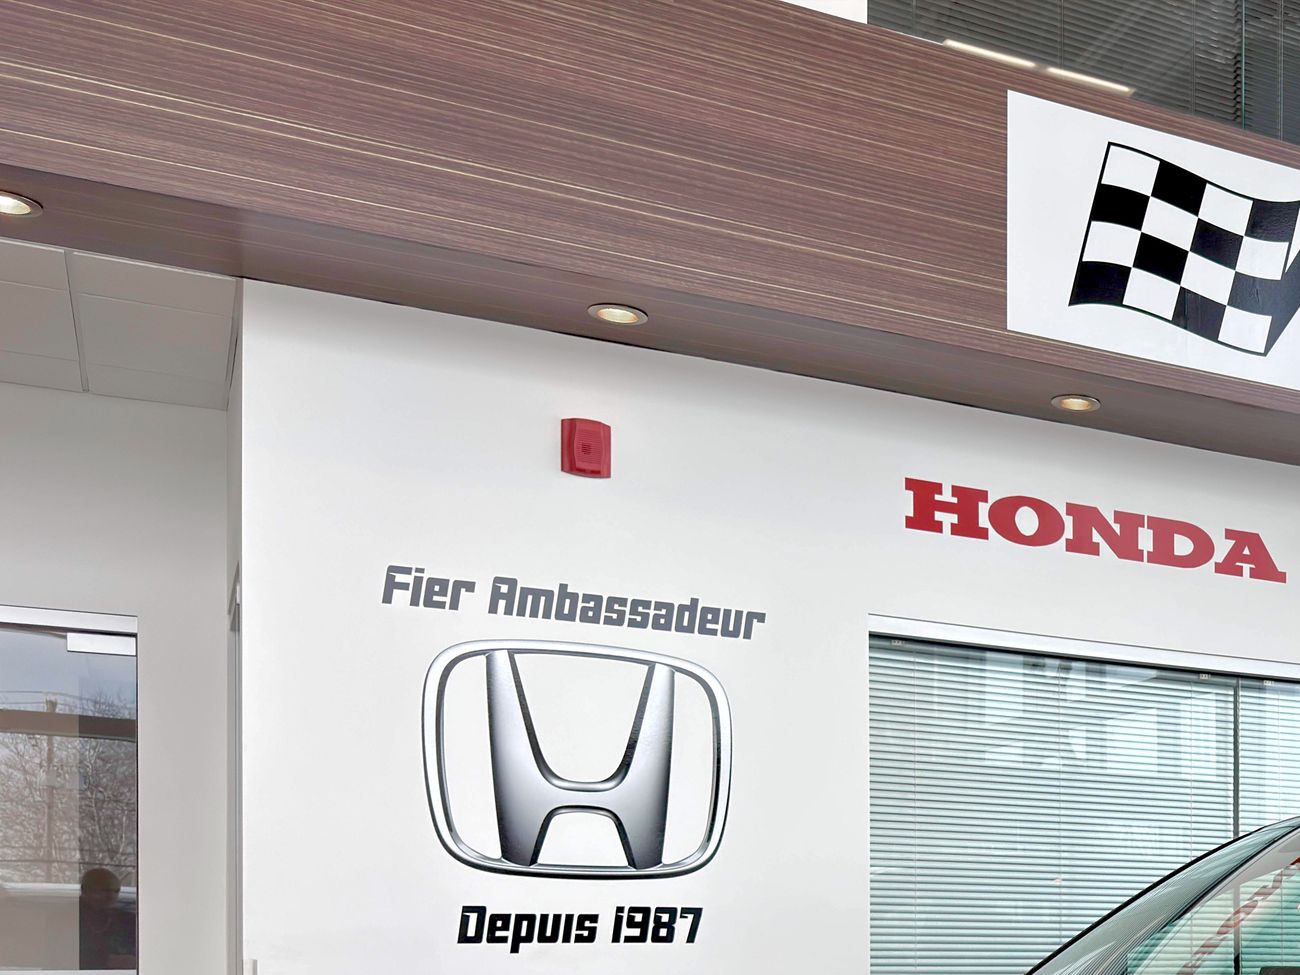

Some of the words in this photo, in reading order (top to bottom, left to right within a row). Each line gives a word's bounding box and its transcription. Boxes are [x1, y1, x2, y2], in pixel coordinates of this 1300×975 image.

[904, 477, 1287, 583] HONDA
[381, 565, 476, 611] Fier
[488, 576, 767, 640] Ambassadeur
[457, 905, 600, 954] Depuis
